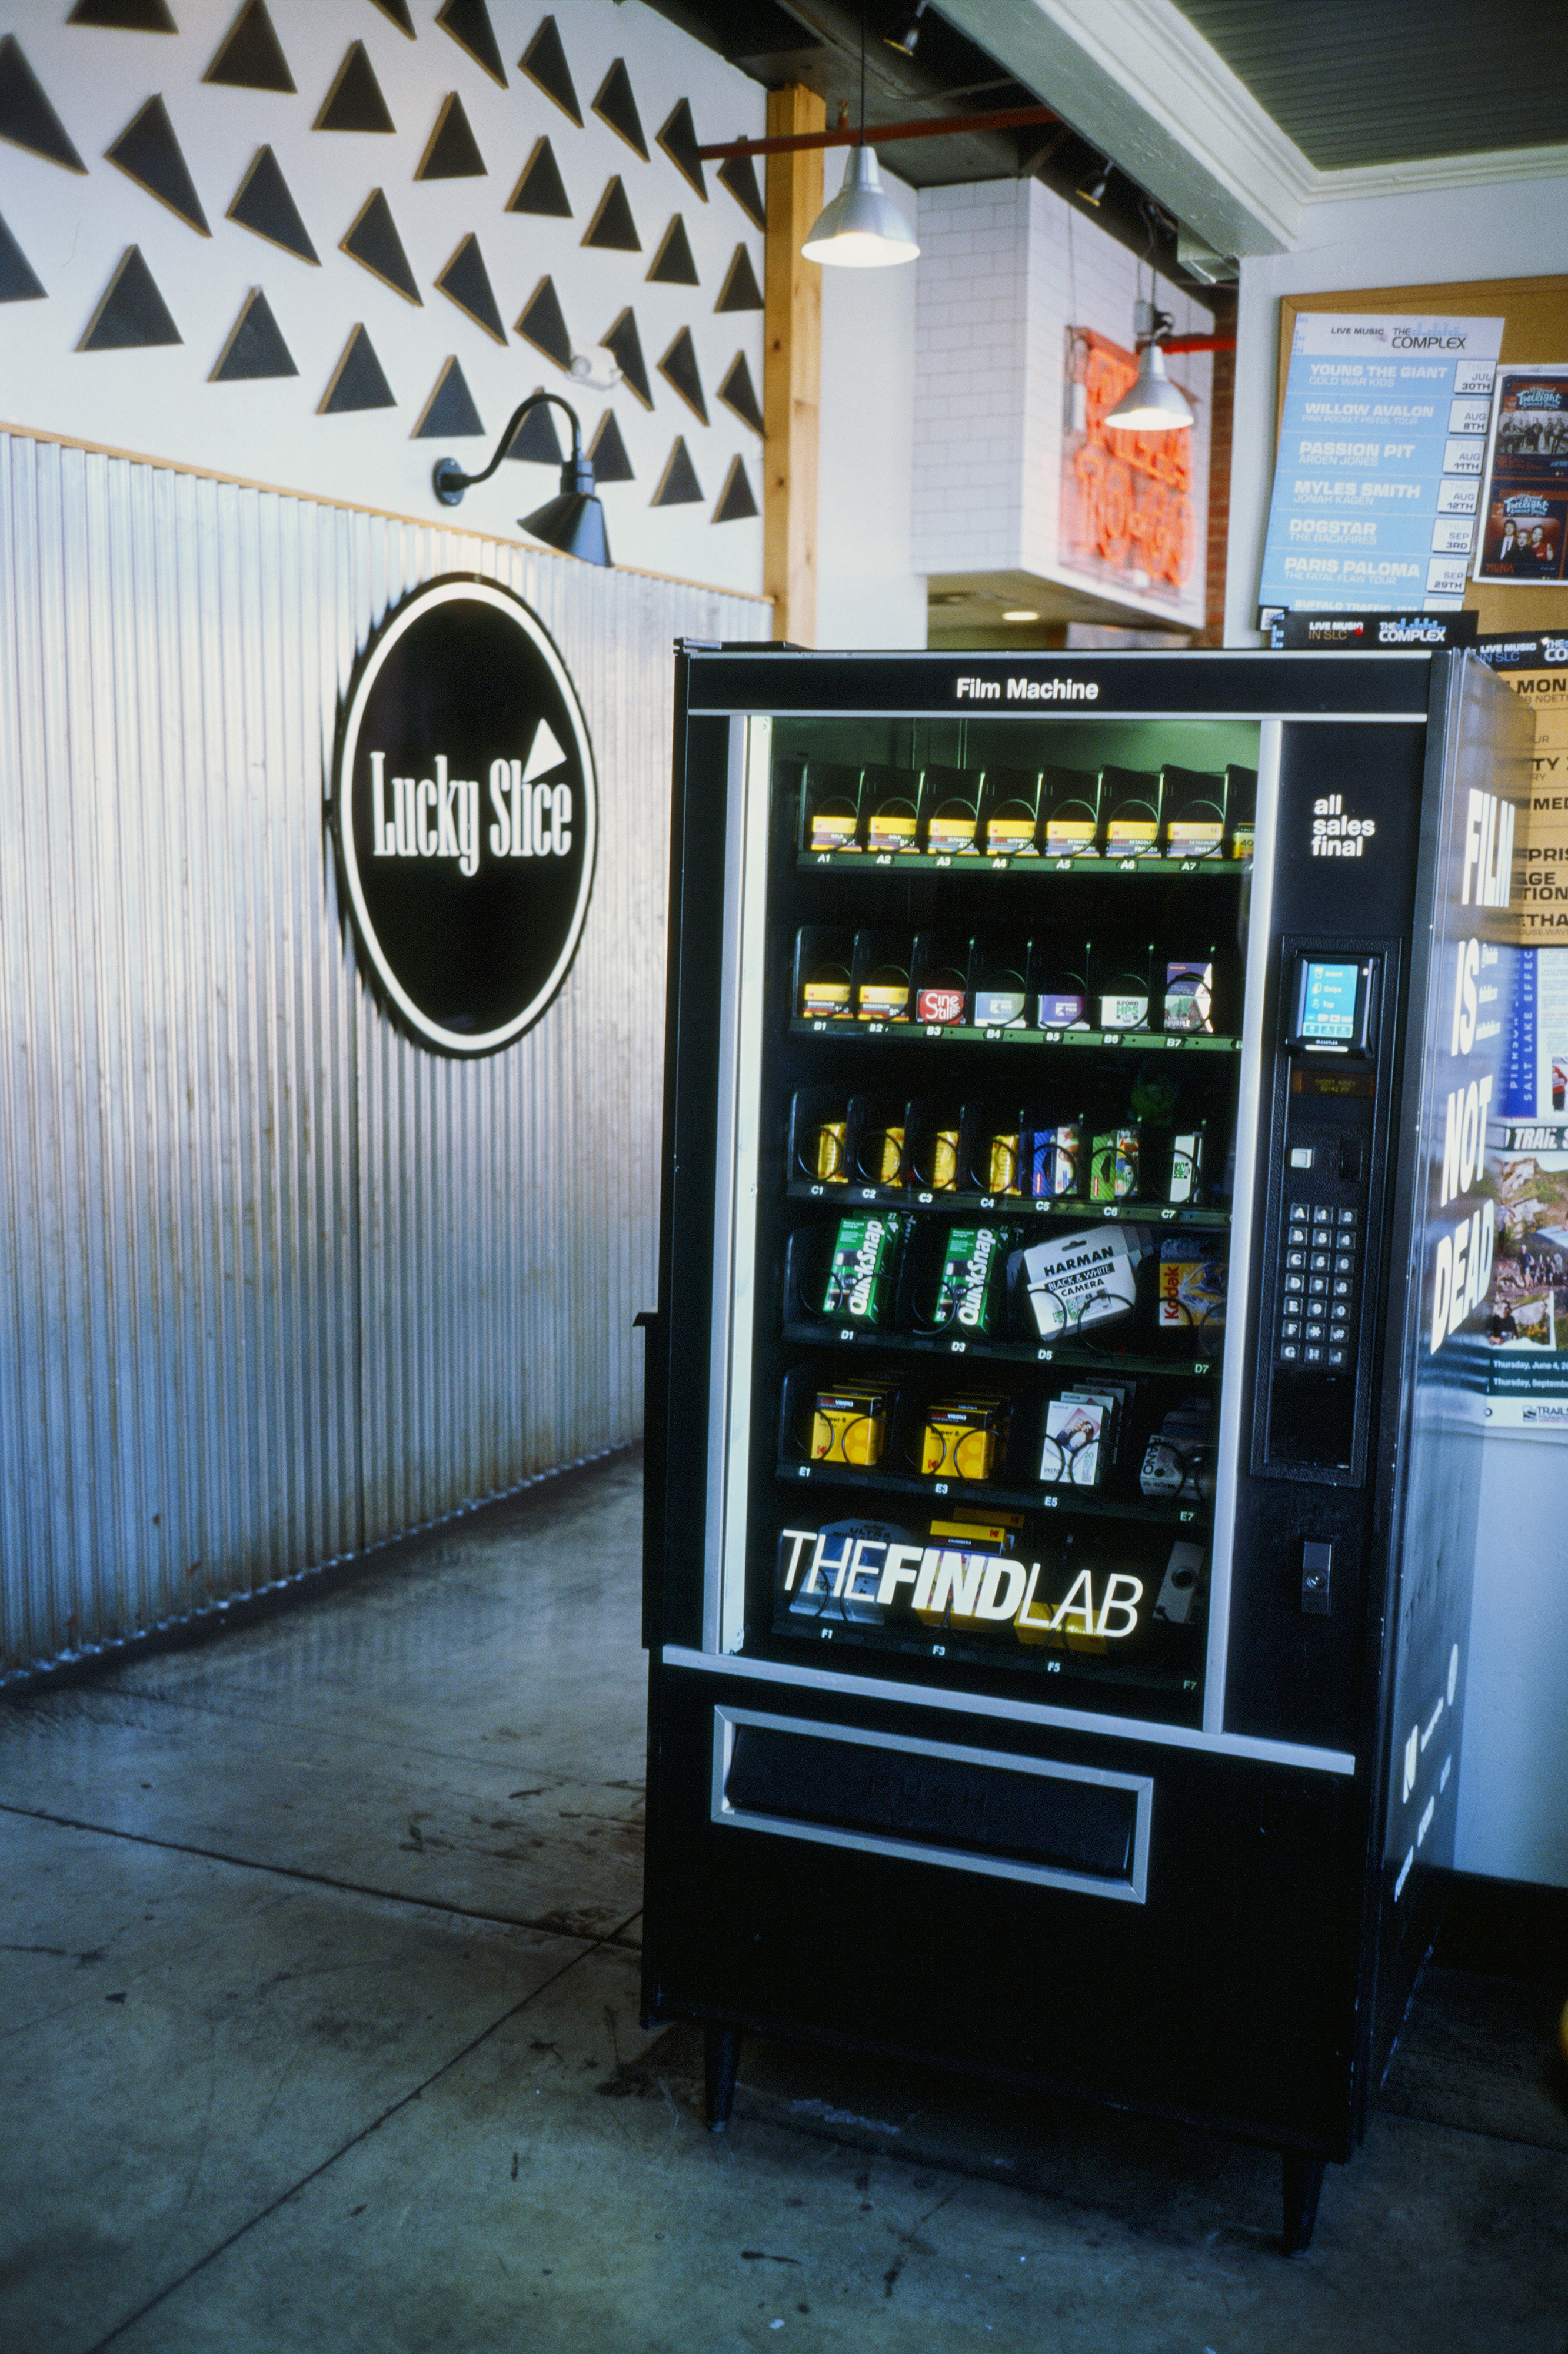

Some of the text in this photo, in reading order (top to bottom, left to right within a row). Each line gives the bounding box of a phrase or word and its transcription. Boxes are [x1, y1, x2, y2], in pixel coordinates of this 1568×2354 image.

[1392, 337, 1466, 350] COMPLEX
[1311, 364, 1447, 378] YOUNG THE GIANT
[1472, 373, 1492, 381] JUL
[1309, 377, 1395, 387] COLD WAR KIDS
[1516, 390, 1562, 406] Twilight
[1305, 403, 1434, 417] WILLOW AVALON
[1299, 441, 1415, 458] PASSION PIT
[1299, 455, 1379, 467] ARDEN JONES
[1294, 480, 1421, 498] MYLES SMITH
[1294, 494, 1374, 506] JONAH KAGEN
[1503, 497, 1549, 513] Twilight
[1289, 518, 1377, 535] DOGSTAR
[1290, 533, 1377, 545] THE BACKFIRES
[1285, 557, 1420, 578] PARIS PALOMA
[1285, 571, 1396, 585] THE FATAL FLAW TOUR
[1434, 581, 1462, 589] 29TH
[1294, 599, 1391, 611] BUFFALO TRAFFIC
[1309, 621, 1364, 631] LIVE MUSIC
[1379, 622, 1397, 630] THE
[1308, 630, 1347, 640] IN SLC
[1378, 629, 1446, 642] COMPLEX
[1480, 642, 1537, 653] LIVE MUSIC
[1547, 639, 1564, 649] THE
[1495, 651, 1520, 663] SLC
[956, 677, 1099, 701] Film Machine
[1314, 794, 1341, 816] all
[370, 751, 572, 876] Lucky Slice
[1313, 816, 1376, 837] sales
[1311, 835, 1363, 857] final
[1463, 787, 1515, 909] FILM
[817, 853, 831, 863] A1
[876, 855, 891, 865] A2
[937, 856, 951, 866] A3
[992, 858, 1007, 868] A4
[1056, 859, 1071, 869] A5
[1120, 860, 1136, 869] A6
[1181, 861, 1197, 871] A7
[1324, 985, 1343, 993] Swipe
[925, 992, 959, 1008] Cine
[1451, 937, 1480, 1057] IS
[1116, 1006, 1139, 1015] HP5
[1322, 1000, 1335, 1009] Tap
[925, 1002, 953, 1020] Still
[814, 1021, 827, 1030] B1
[869, 1023, 883, 1033] B2
[926, 1026, 941, 1036] B3
[986, 1029, 1000, 1039] B4
[1046, 1032, 1060, 1042] B5
[1524, 1012, 1533, 1052] LAKE
[1104, 1034, 1118, 1044] B6
[1167, 1038, 1181, 1047] B7
[1524, 1063, 1533, 1102] SALT
[1441, 1075, 1493, 1208] NOT
[1514, 1127, 1558, 1150] TRAIL
[811, 1186, 823, 1195] C1
[862, 1189, 877, 1199] C2
[919, 1193, 933, 1203] C3
[980, 1198, 994, 1208] C4
[1036, 1201, 1050, 1211] C5
[1103, 1206, 1118, 1216] C6
[1161, 1209, 1176, 1219] C7
[1294, 1207, 1305, 1219] A
[1343, 1211, 1353, 1222] 2
[1294, 1229, 1349, 1246] B 4
[1043, 1246, 1114, 1277] HARMAN
[1291, 1254, 1349, 1269] C 6
[1048, 1265, 1110, 1291] BLACK & WHITE
[1431, 1199, 1495, 1355] DEAD
[1061, 1278, 1104, 1296] CAMERA
[1291, 1276, 1347, 1293] D 8
[1164, 1265, 1179, 1319] Kodak
[1289, 1300, 1346, 1316] E 0
[841, 1329, 854, 1341] D1
[1287, 1324, 1297, 1334] F
[951, 1341, 966, 1352] D3
[1038, 1349, 1052, 1361] D5
[1285, 1346, 1342, 1363] G H J
[1194, 1363, 1209, 1374] D7
[1493, 1359, 1560, 1371] Thursday, June 4,
[1493, 1377, 1532, 1388] Thursday,
[799, 1466, 810, 1477] E1
[935, 1483, 948, 1494] E3
[1044, 1496, 1058, 1507] E5
[1180, 1511, 1194, 1522] E7
[821, 1628, 833, 1639] F1
[933, 1644, 946, 1656] F3
[1047, 1661, 1060, 1673] F5
[1183, 1680, 1197, 1690] F7
